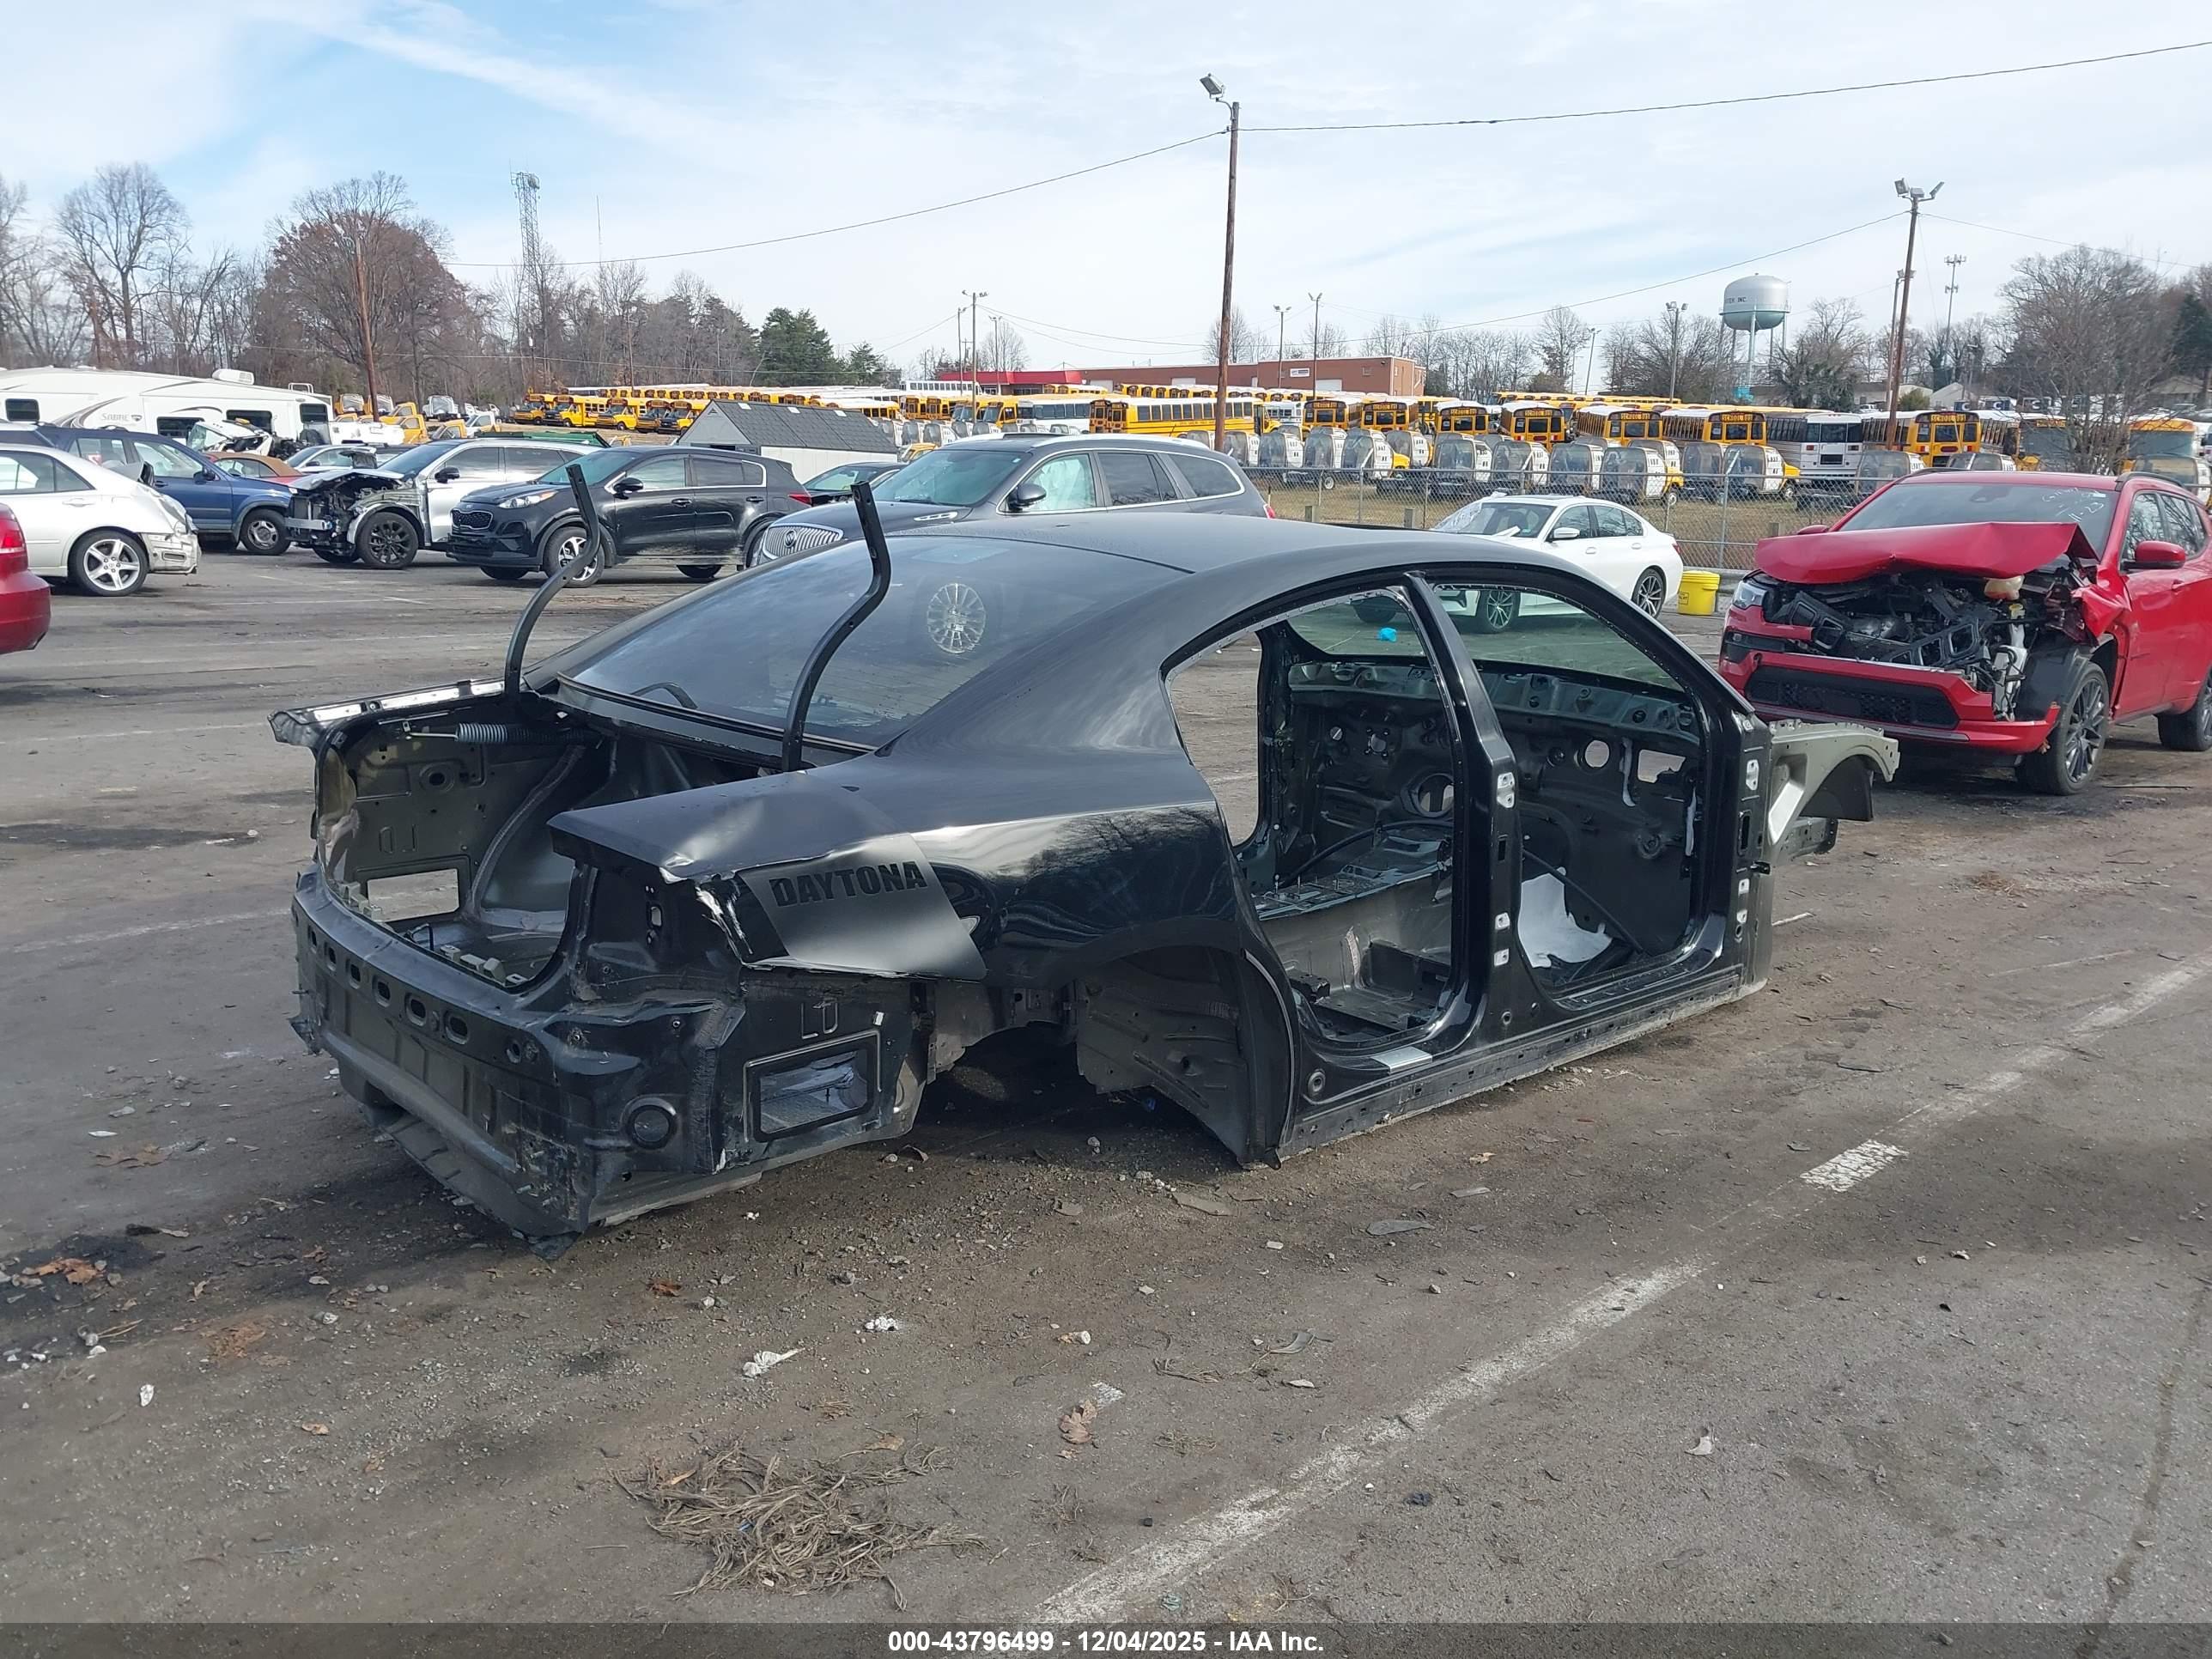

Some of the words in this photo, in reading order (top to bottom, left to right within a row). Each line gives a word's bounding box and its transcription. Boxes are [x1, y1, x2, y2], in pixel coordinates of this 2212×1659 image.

[1931, 414, 1956, 422] SCHOOL
[1957, 414, 1966, 422] BUS
[769, 860, 928, 908] DAYTONA
